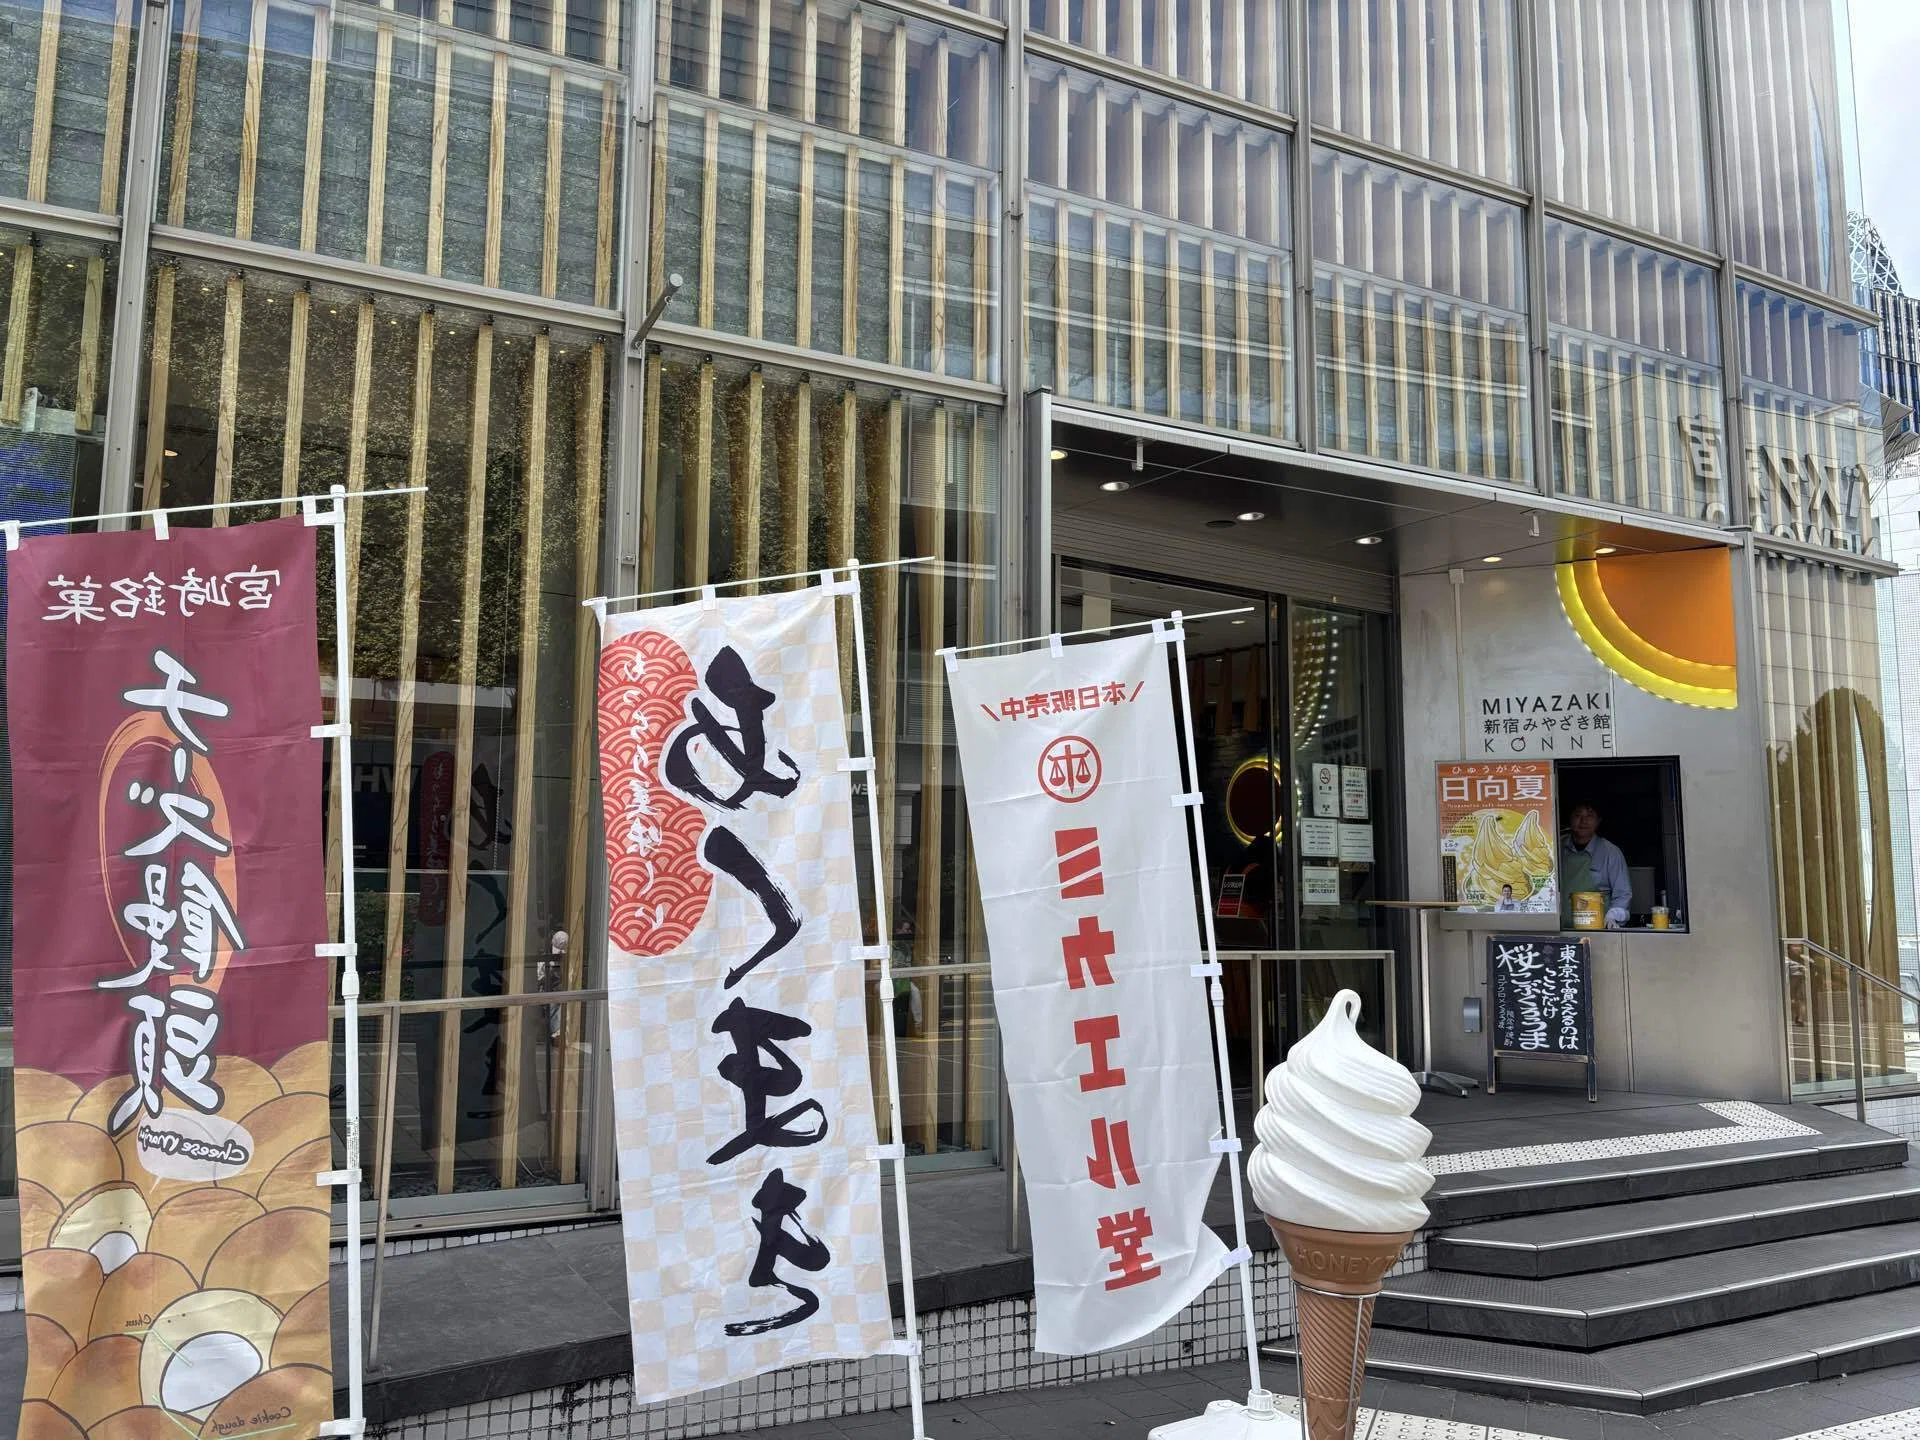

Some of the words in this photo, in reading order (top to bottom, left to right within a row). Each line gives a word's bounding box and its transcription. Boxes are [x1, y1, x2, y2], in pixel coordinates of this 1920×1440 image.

[1482, 692, 1610, 715] MIYAZAKI
[1484, 714, 1610, 734] 新宿みやざき館
[1484, 734, 1612, 753] KONNE
[1452, 764, 1537, 774] ひゅうがなつ
[1441, 774, 1548, 802] 日向夏
[1541, 967, 1560, 1018] ここだけ
[1557, 945, 1580, 1050] 東京で買えるのは
